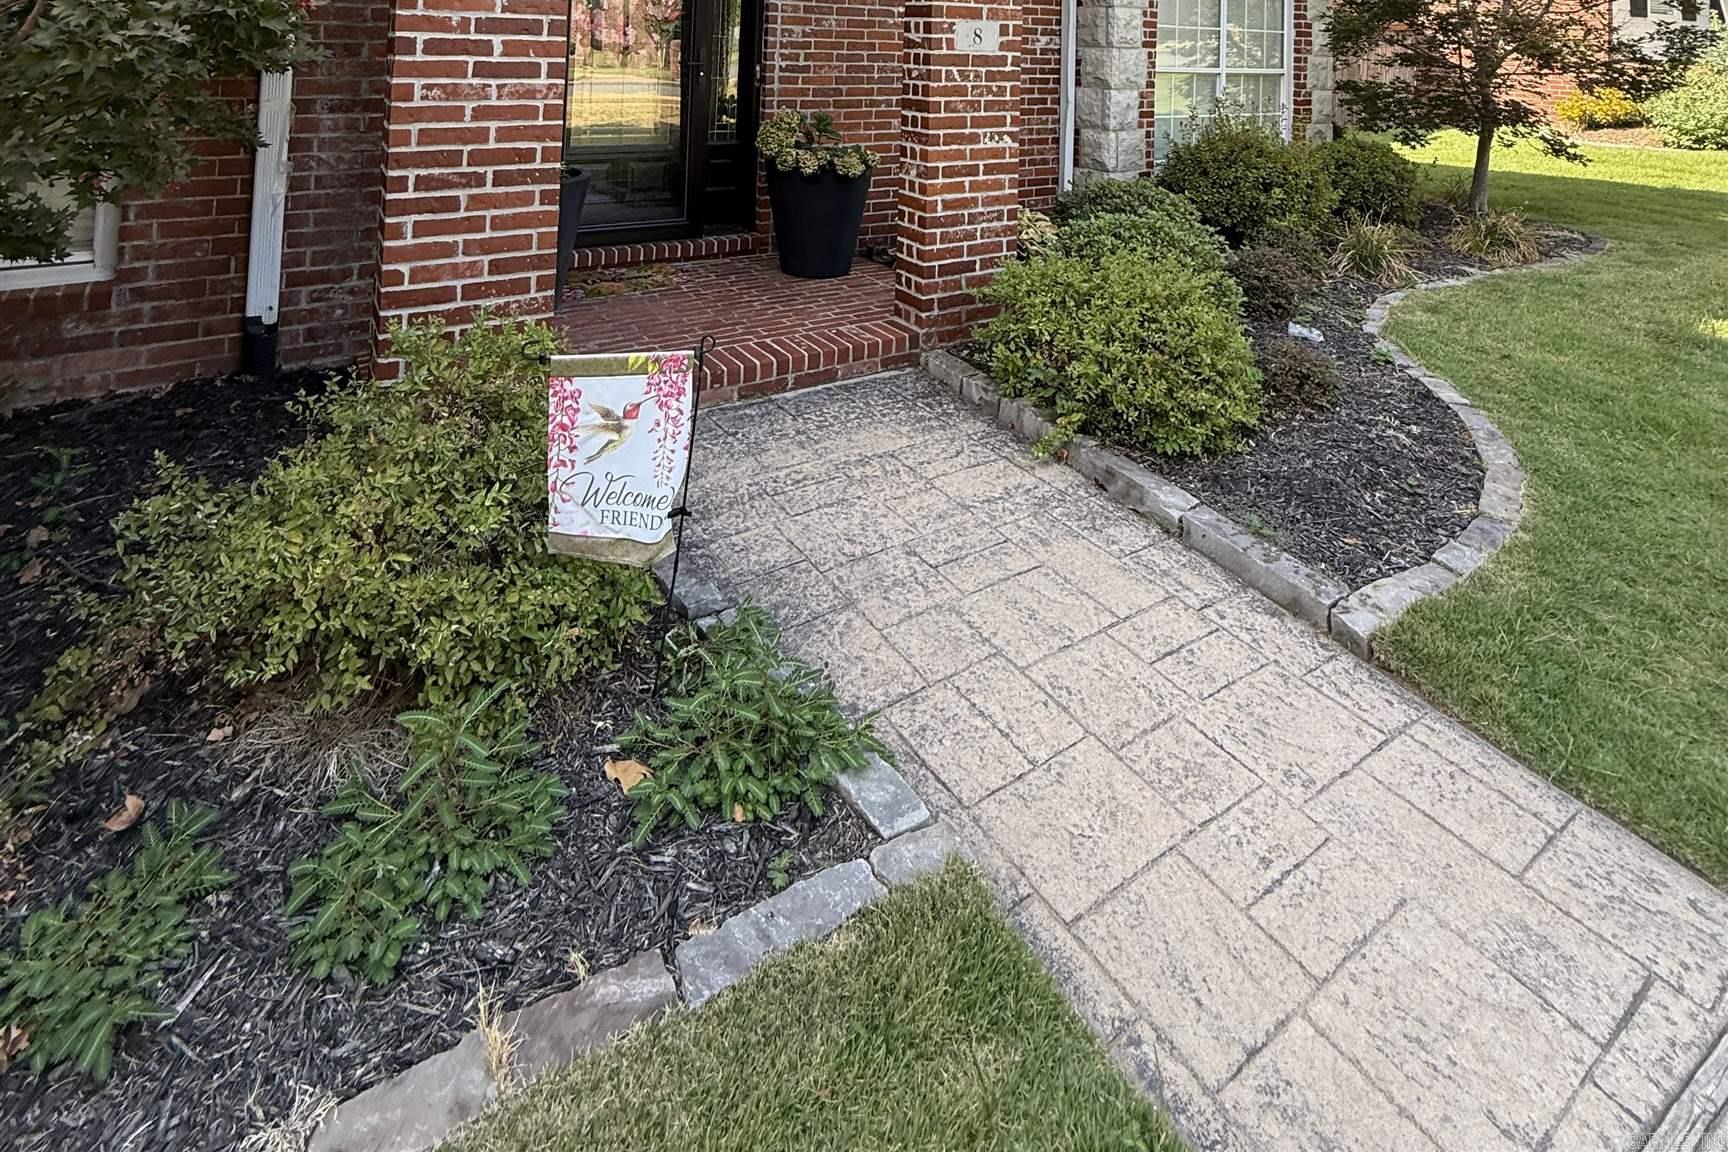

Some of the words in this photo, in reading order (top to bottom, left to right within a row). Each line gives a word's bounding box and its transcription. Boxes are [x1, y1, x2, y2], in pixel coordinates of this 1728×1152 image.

[973, 27, 983, 46] 8
[560, 471, 675, 510] Welcome
[600, 508, 664, 531] FRIEND
